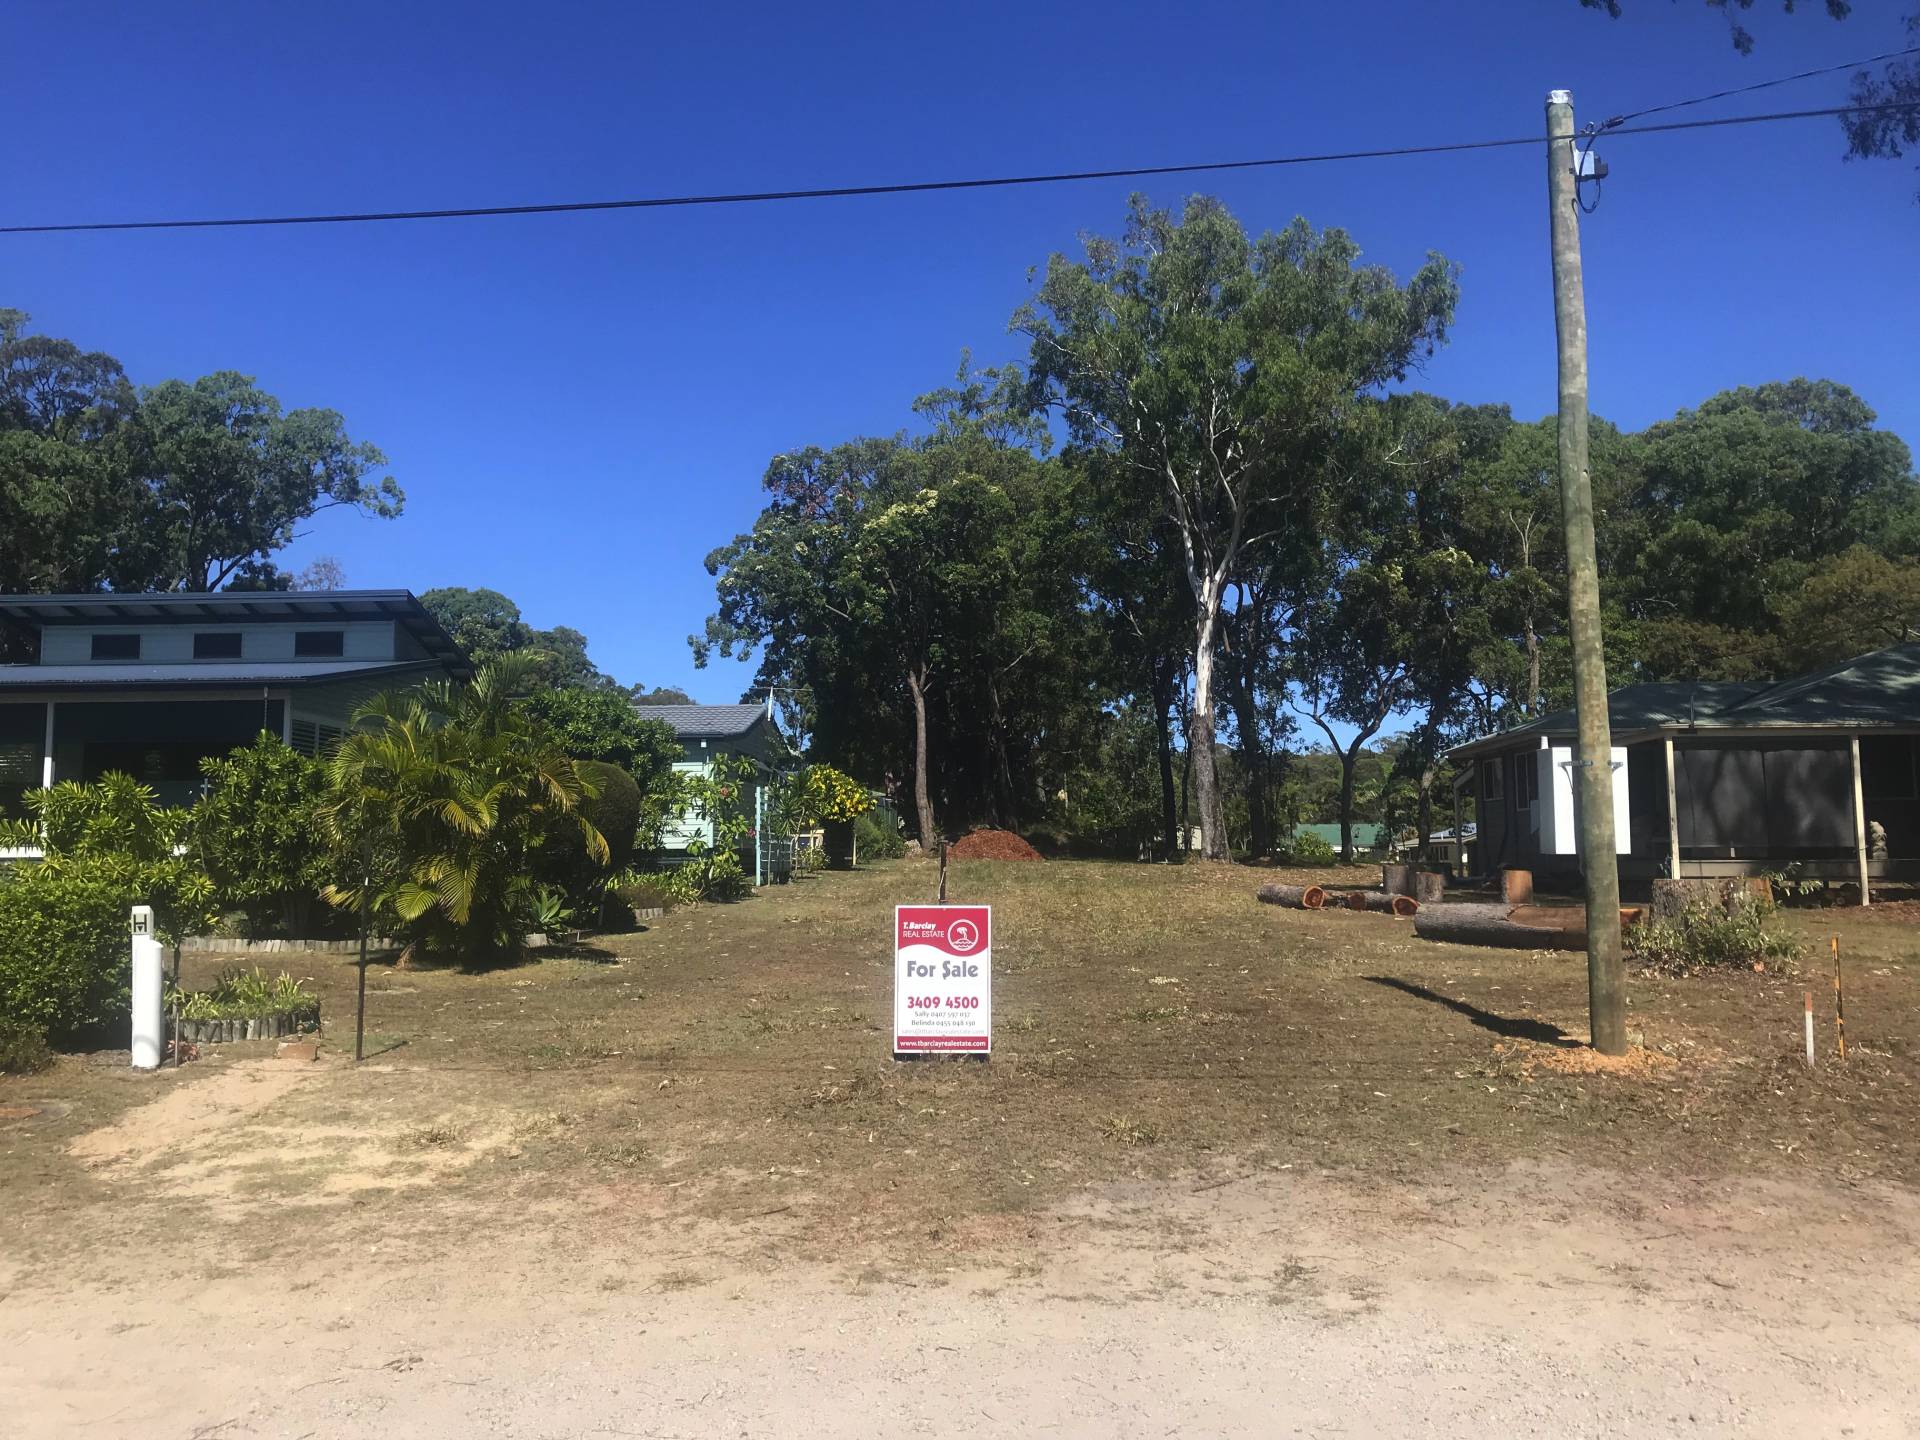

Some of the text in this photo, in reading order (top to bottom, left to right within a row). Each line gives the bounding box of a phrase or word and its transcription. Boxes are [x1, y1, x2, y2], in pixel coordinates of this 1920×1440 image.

[907, 960, 936, 977] For
[907, 996, 979, 1009] 3409 4500
[900, 1040, 986, 1048] www.tbarclayrealestate.com
